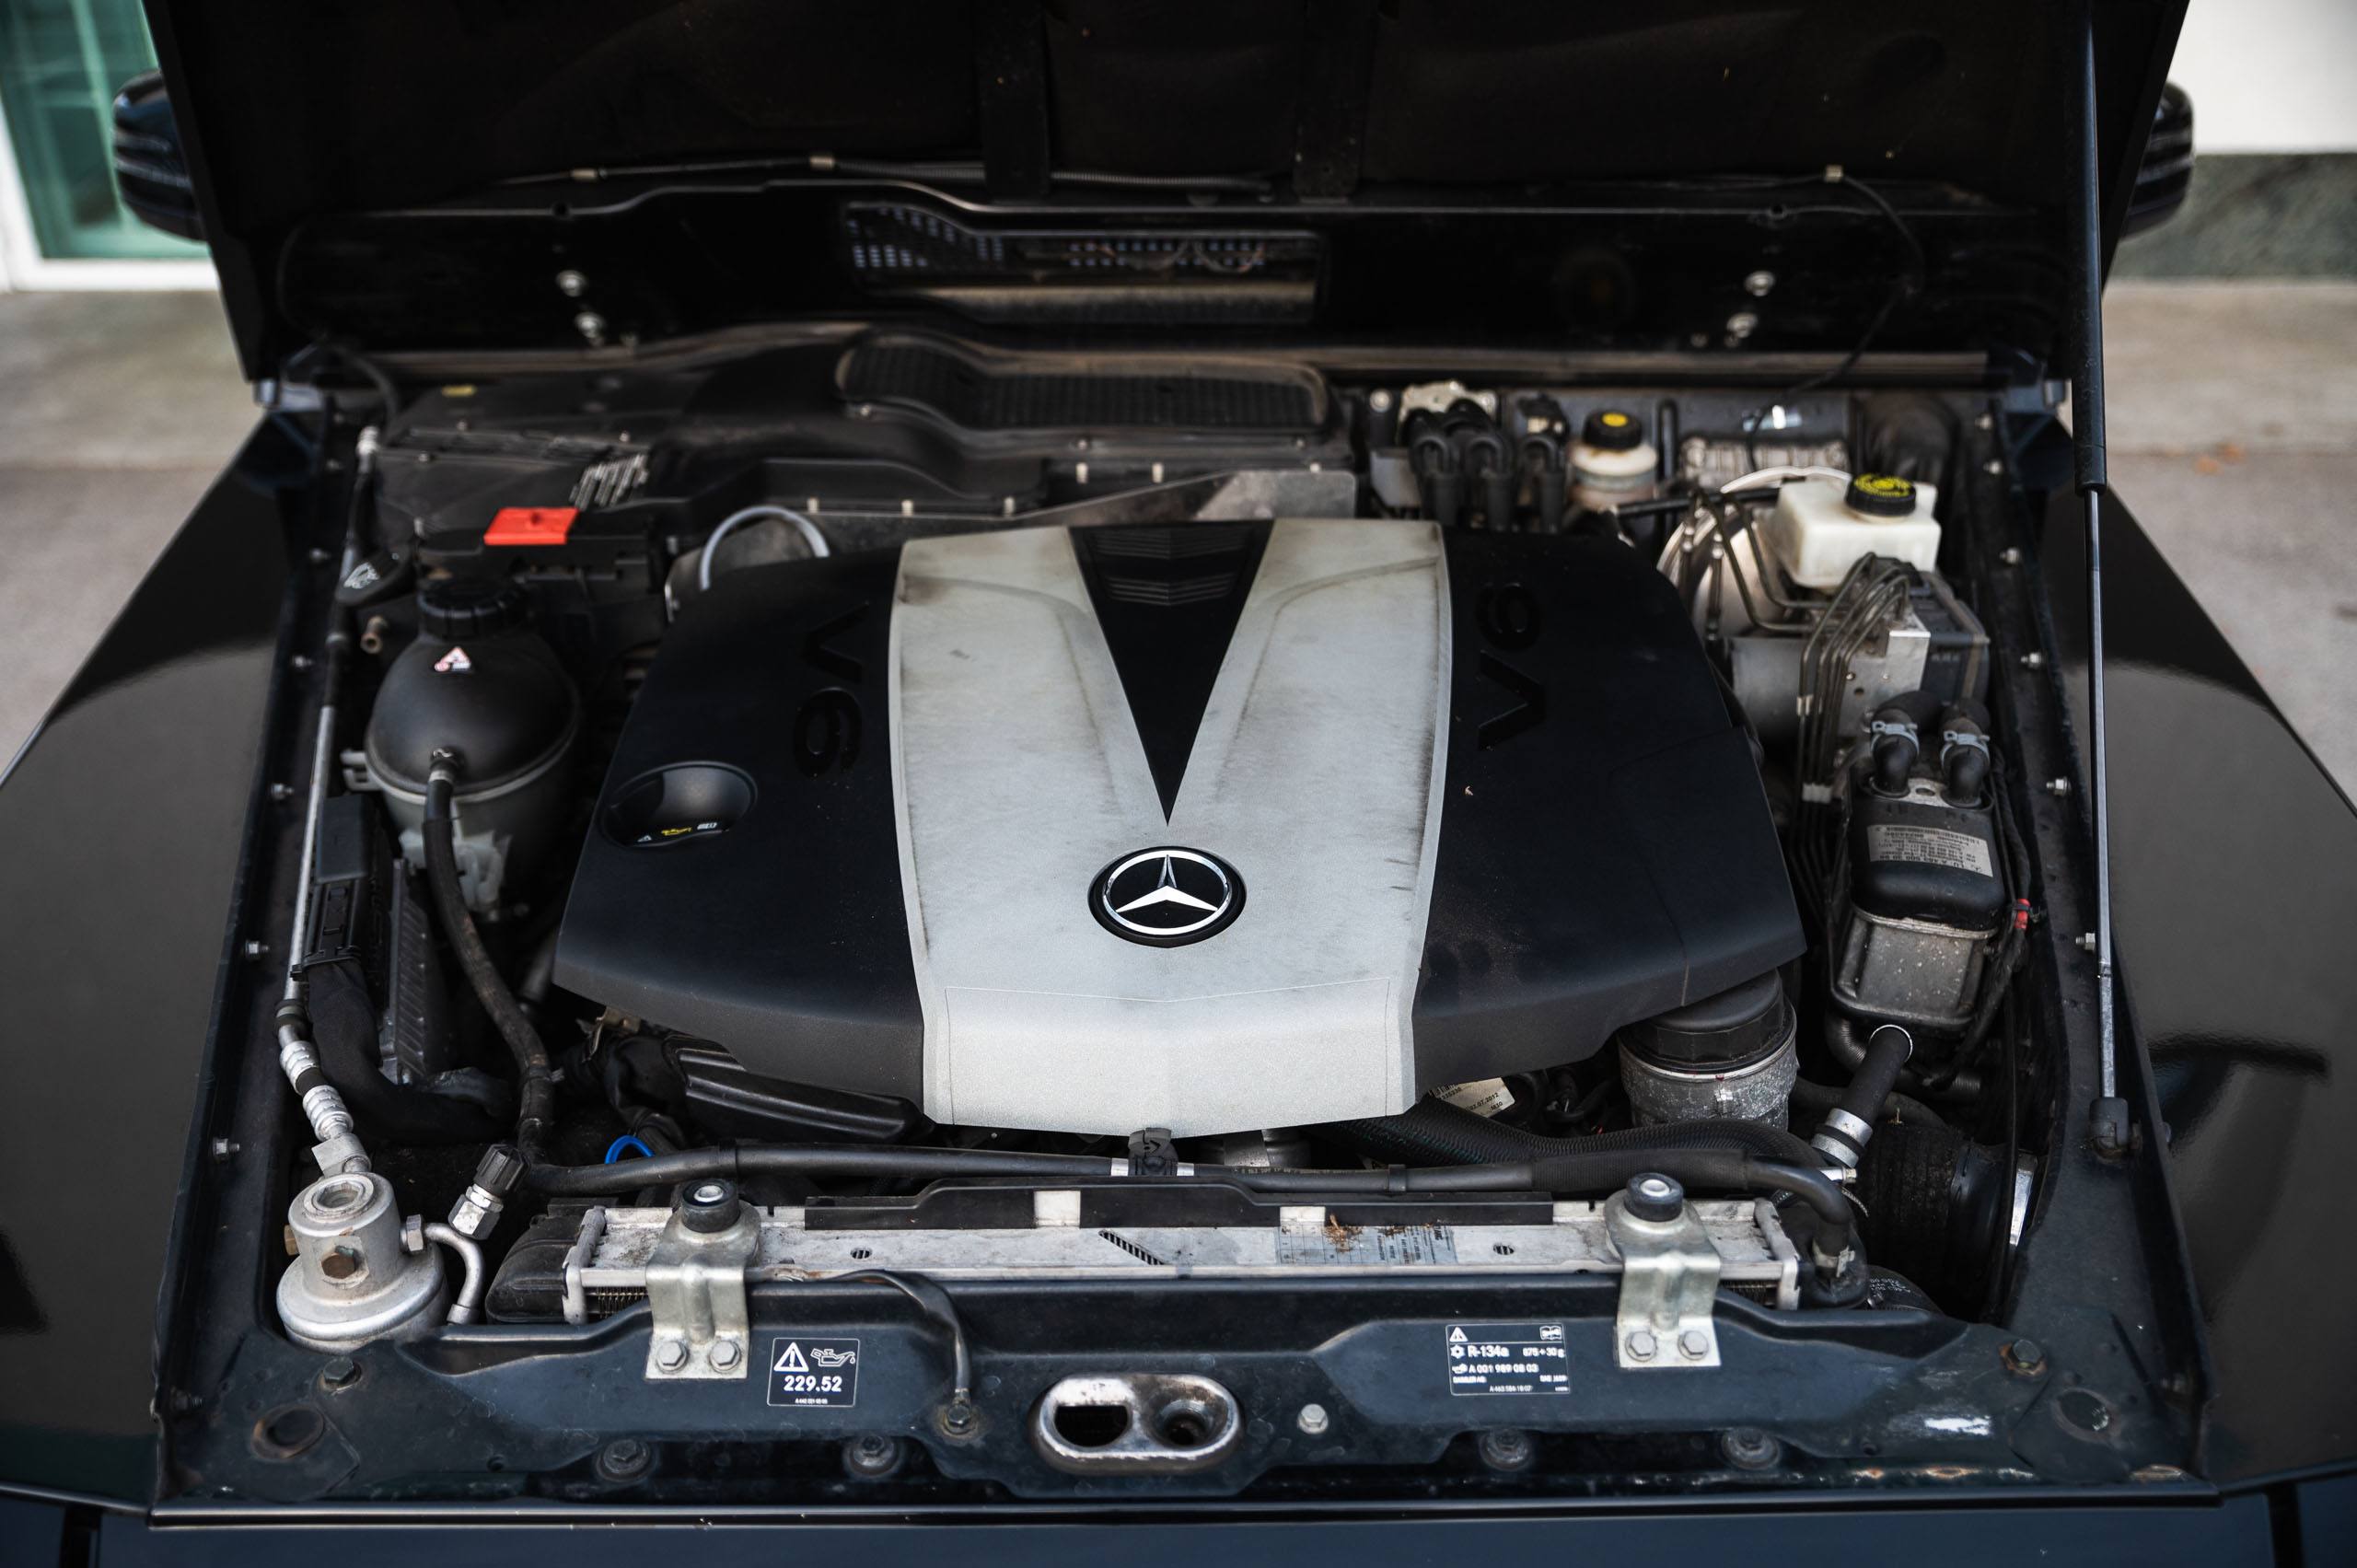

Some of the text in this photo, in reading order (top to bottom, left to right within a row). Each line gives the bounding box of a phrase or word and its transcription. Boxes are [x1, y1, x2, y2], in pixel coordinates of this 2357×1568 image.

[1475, 582, 1547, 752] V6
[794, 600, 870, 779] V6
[1467, 1344, 1510, 1357] R-134a
[1469, 1364, 1477, 1374] A
[784, 1375, 842, 1392] 229.52
